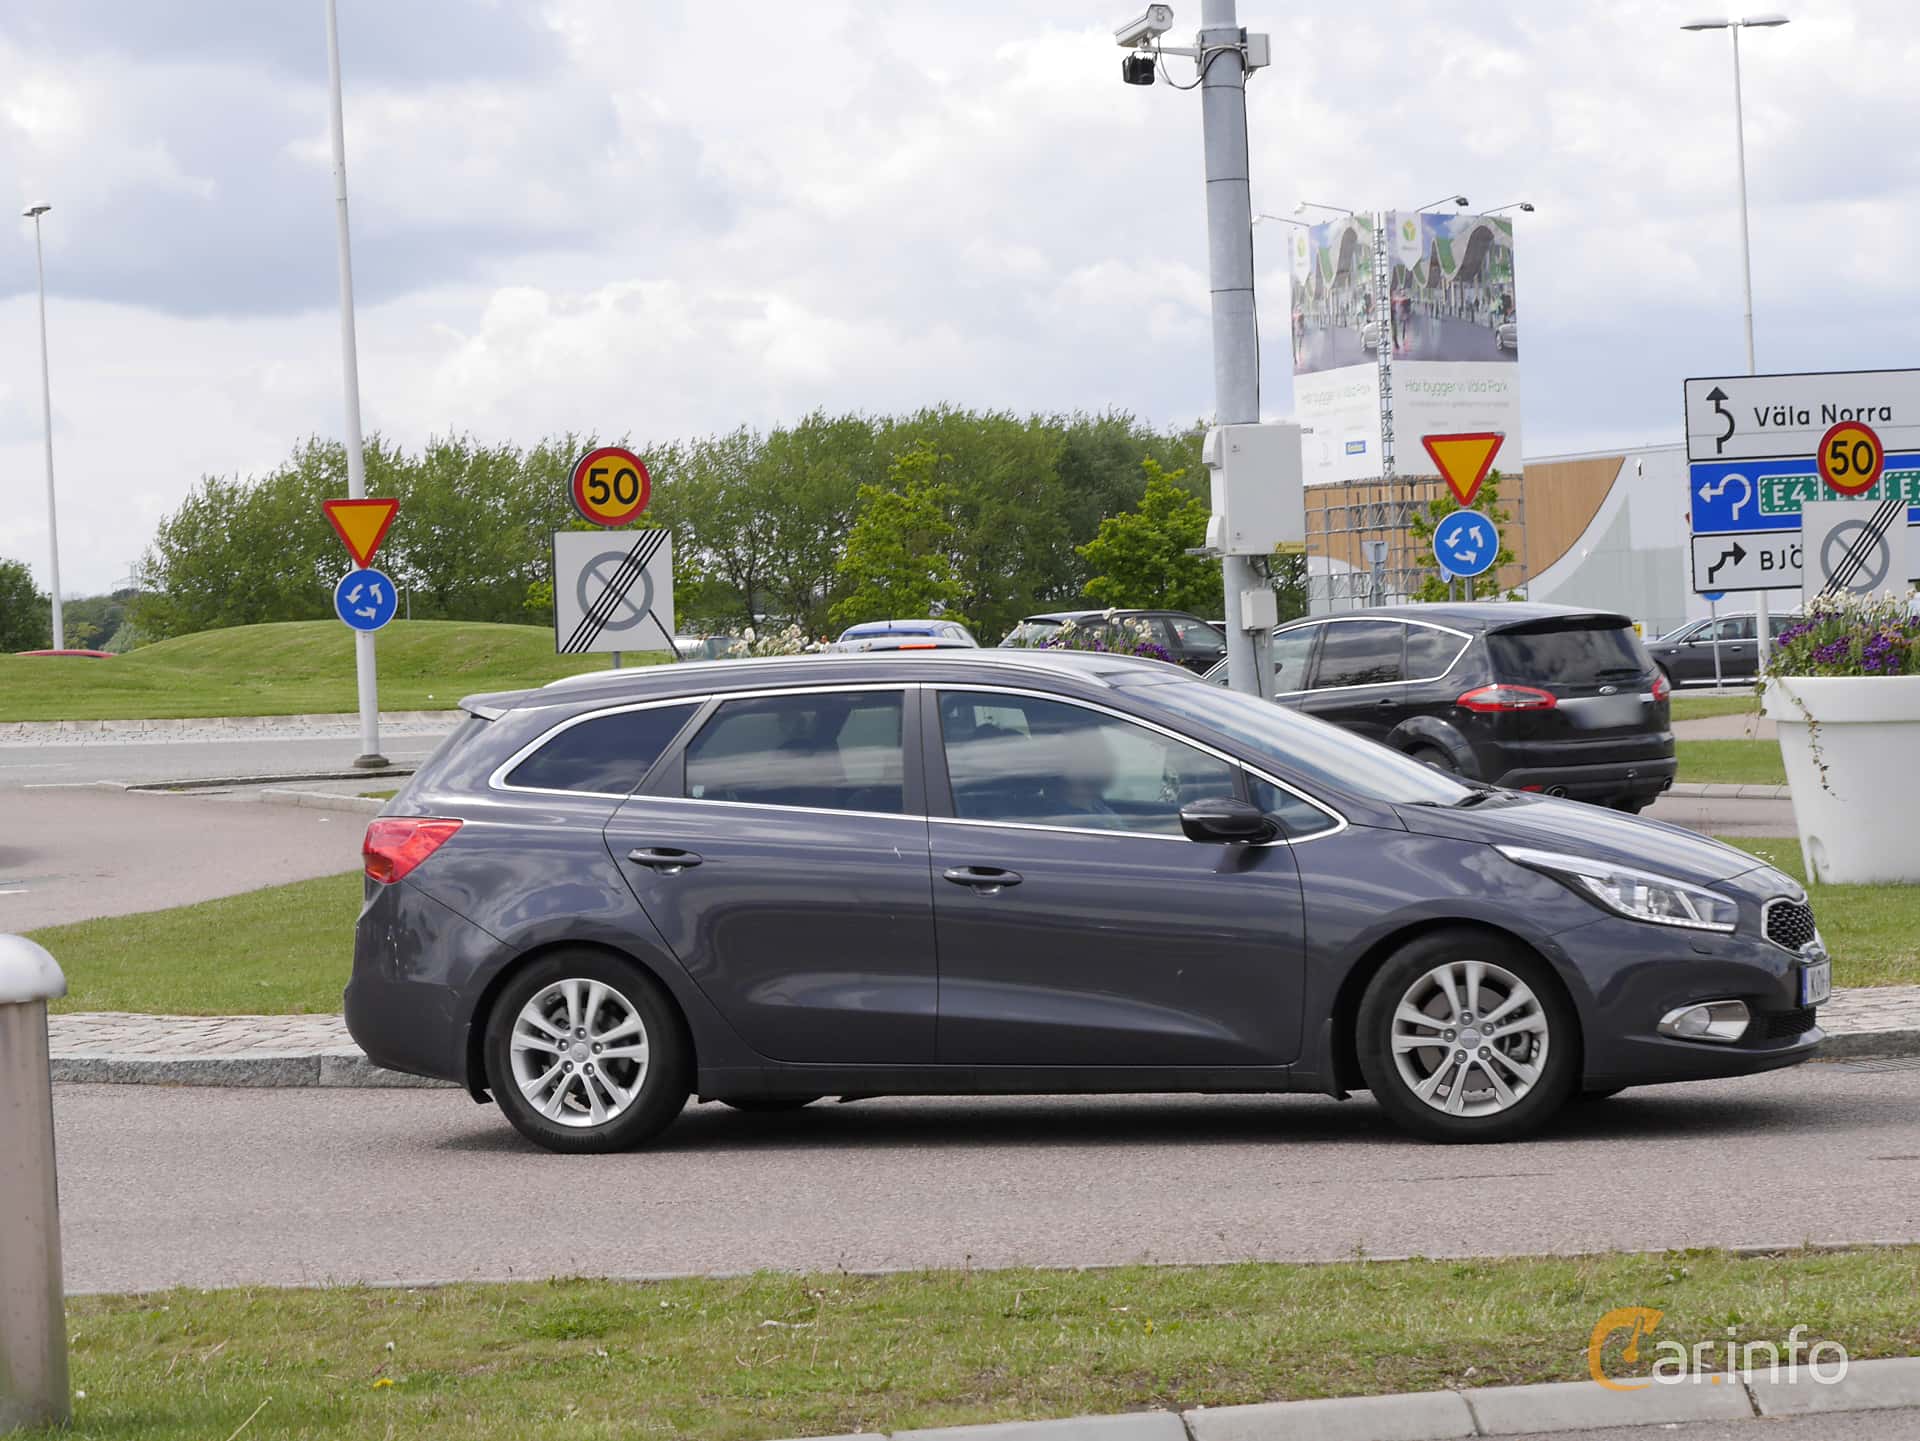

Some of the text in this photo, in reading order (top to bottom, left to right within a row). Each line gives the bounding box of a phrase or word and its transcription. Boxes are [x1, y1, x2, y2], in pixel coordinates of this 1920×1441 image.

[1754, 403, 1892, 427] Väla Norra
[1830, 440, 1874, 476] 50
[588, 467, 640, 505] 50
[1772, 478, 1920, 506] E4 E
